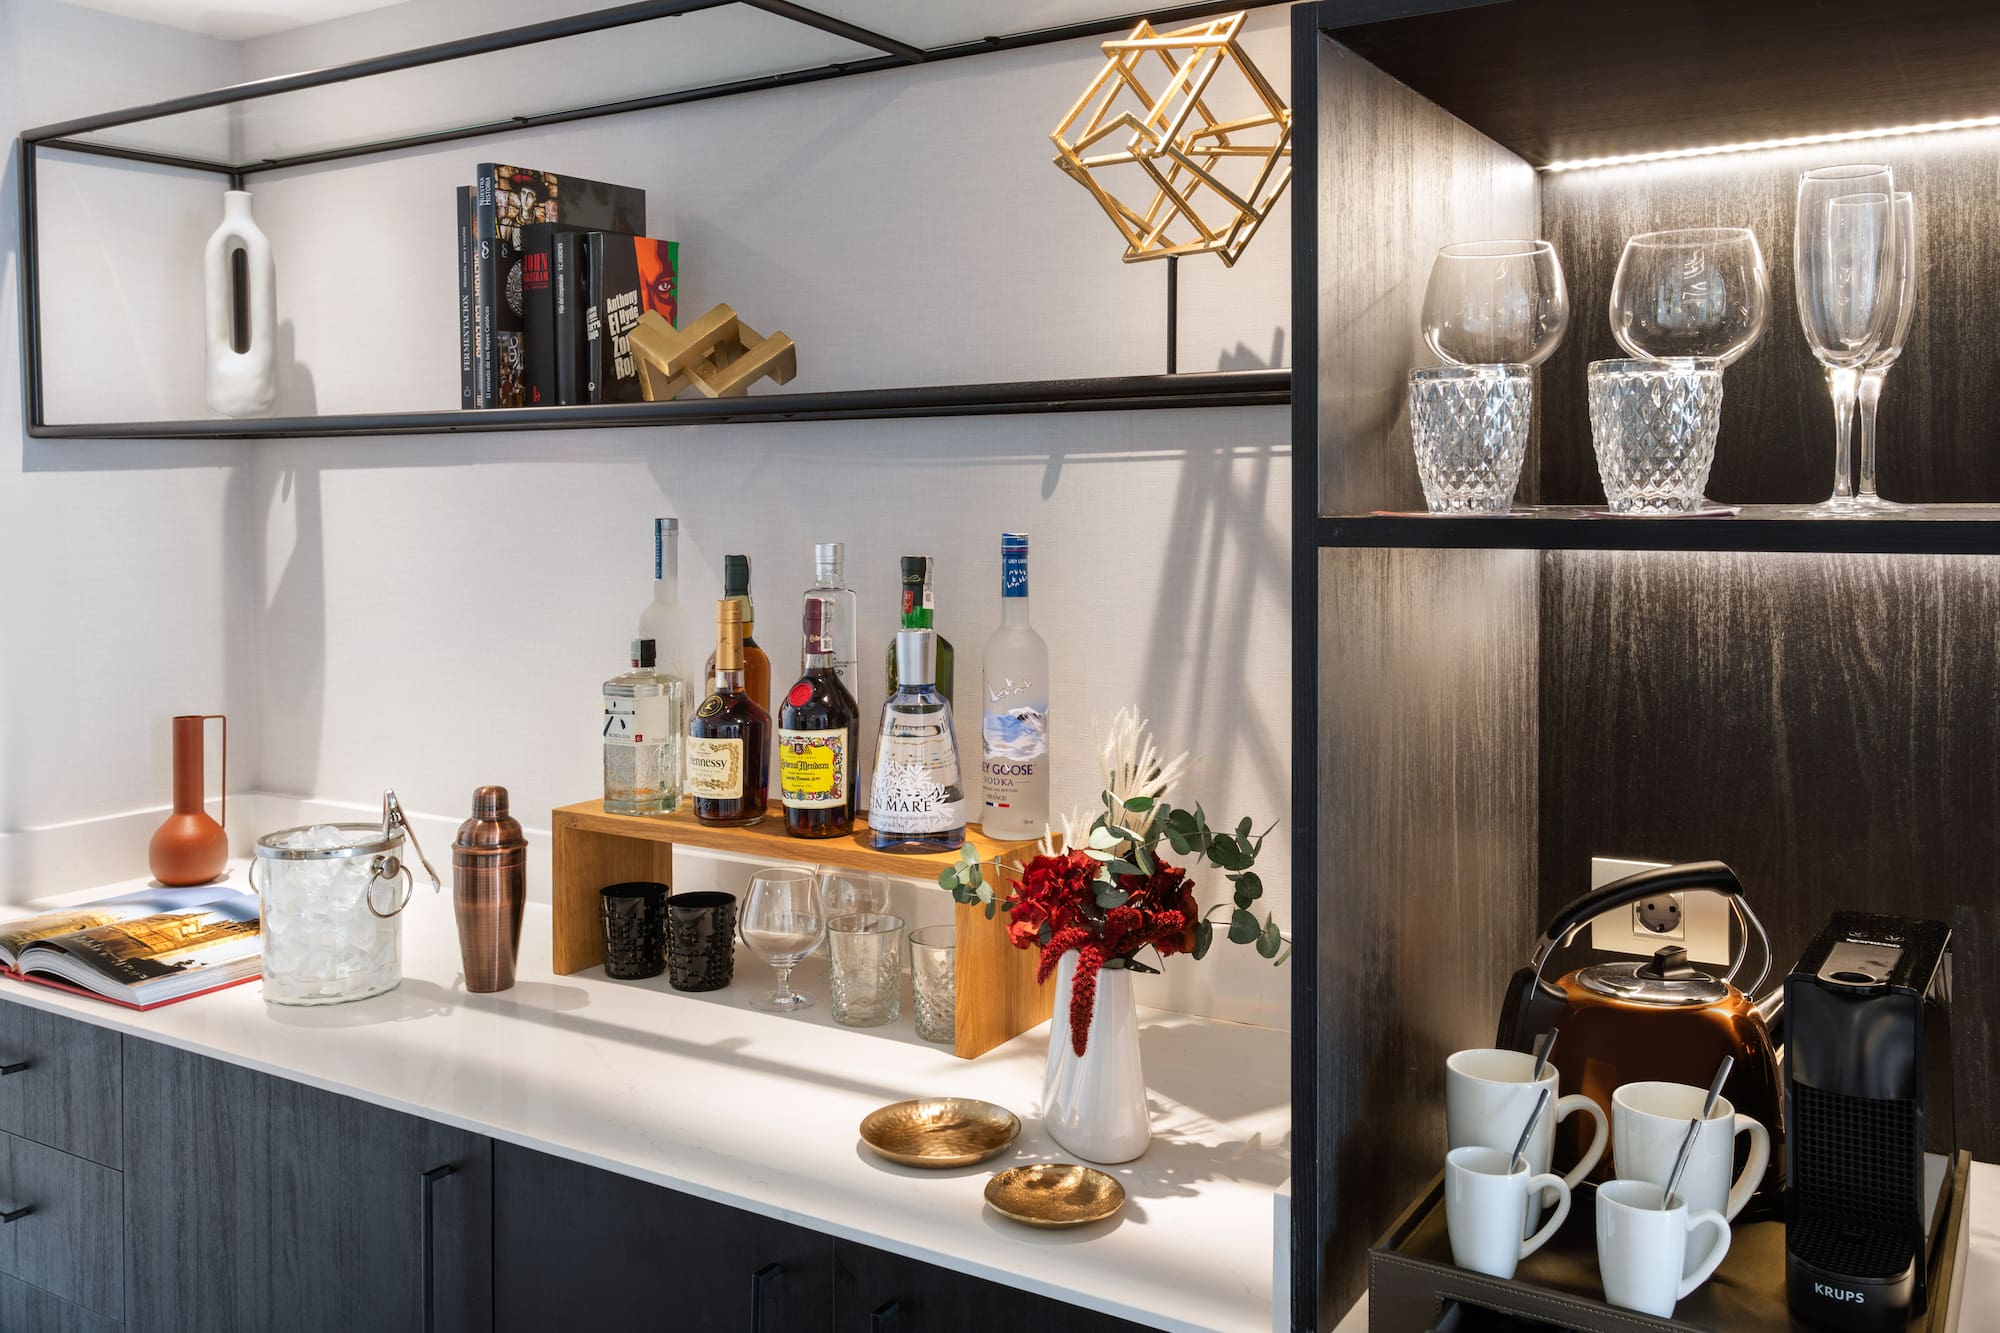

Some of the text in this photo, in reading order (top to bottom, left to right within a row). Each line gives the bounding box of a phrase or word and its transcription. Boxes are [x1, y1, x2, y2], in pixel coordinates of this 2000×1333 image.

[523, 252, 548, 272] JOHN
[607, 290, 637, 314] Anthony
[607, 311, 620, 338] El
[619, 306, 639, 326] Hyde
[614, 352, 637, 380] Roj
[992, 764, 1033, 776] GOOSE
[885, 800, 932, 812] MARE
[1814, 1282, 1865, 1304] KRUPS
